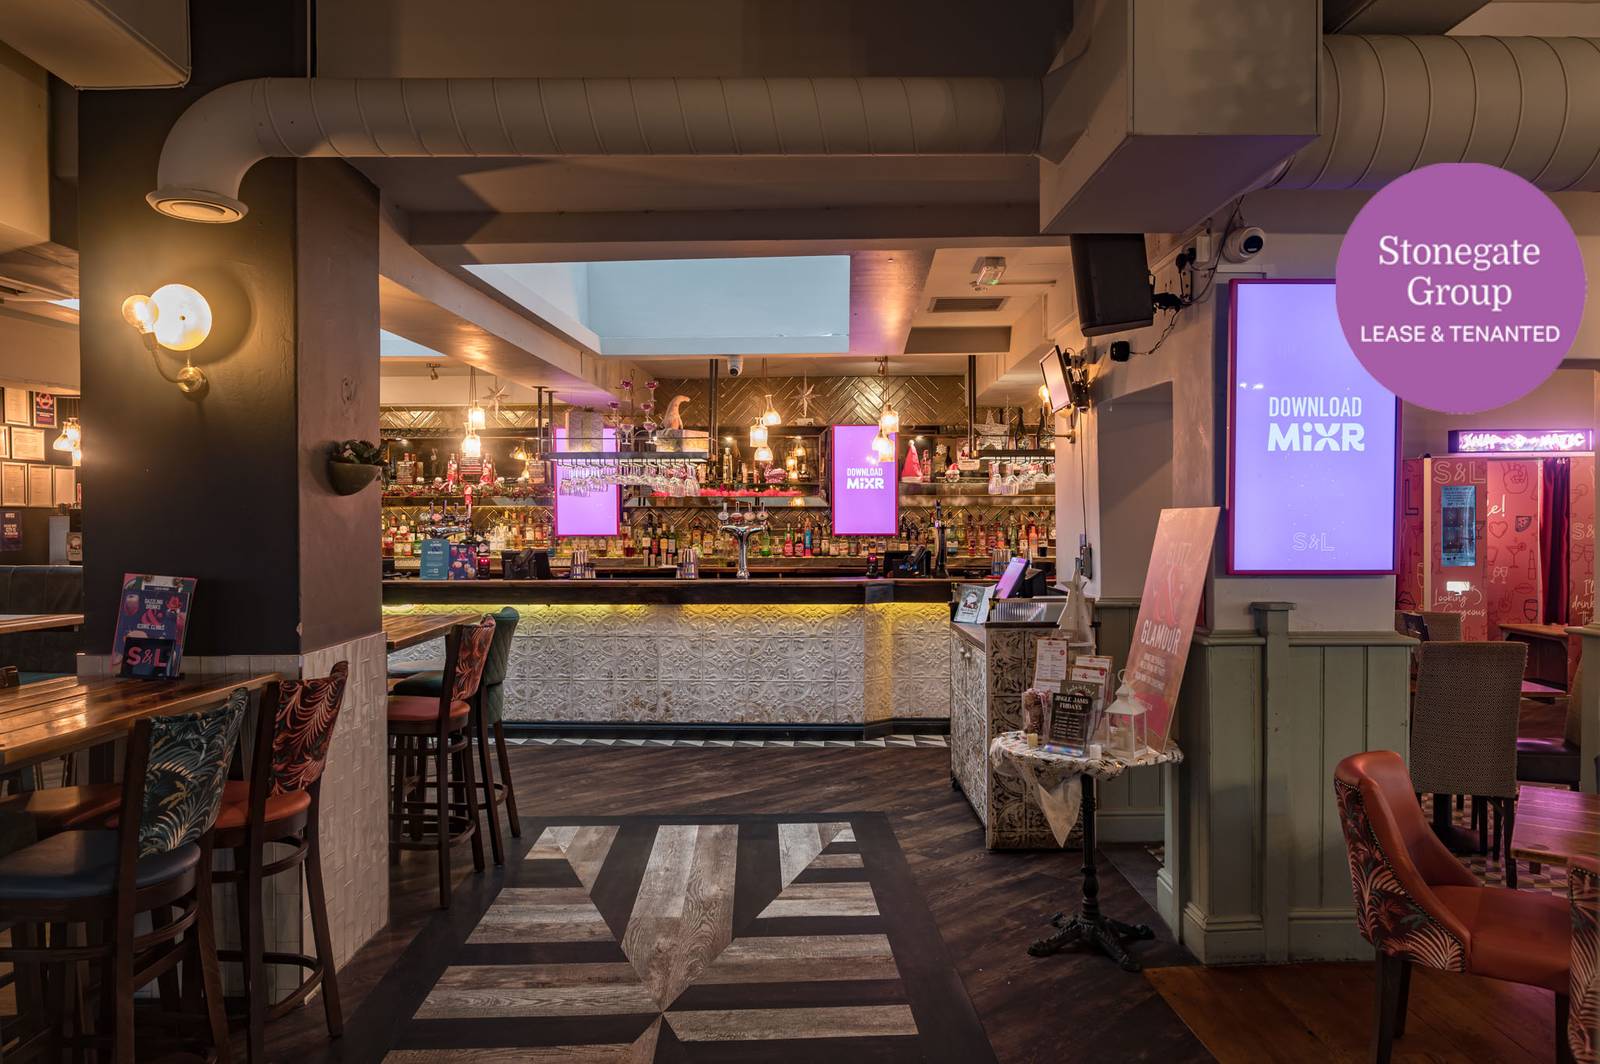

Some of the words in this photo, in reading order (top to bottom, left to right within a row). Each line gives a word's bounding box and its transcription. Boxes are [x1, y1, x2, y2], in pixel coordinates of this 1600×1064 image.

[1268, 396, 1362, 417] DOWNLOAD
[847, 467, 883, 477] DOWNLOAD
[1140, 619, 1182, 656] GLAMOUR
[127, 645, 168, 668] S&L
